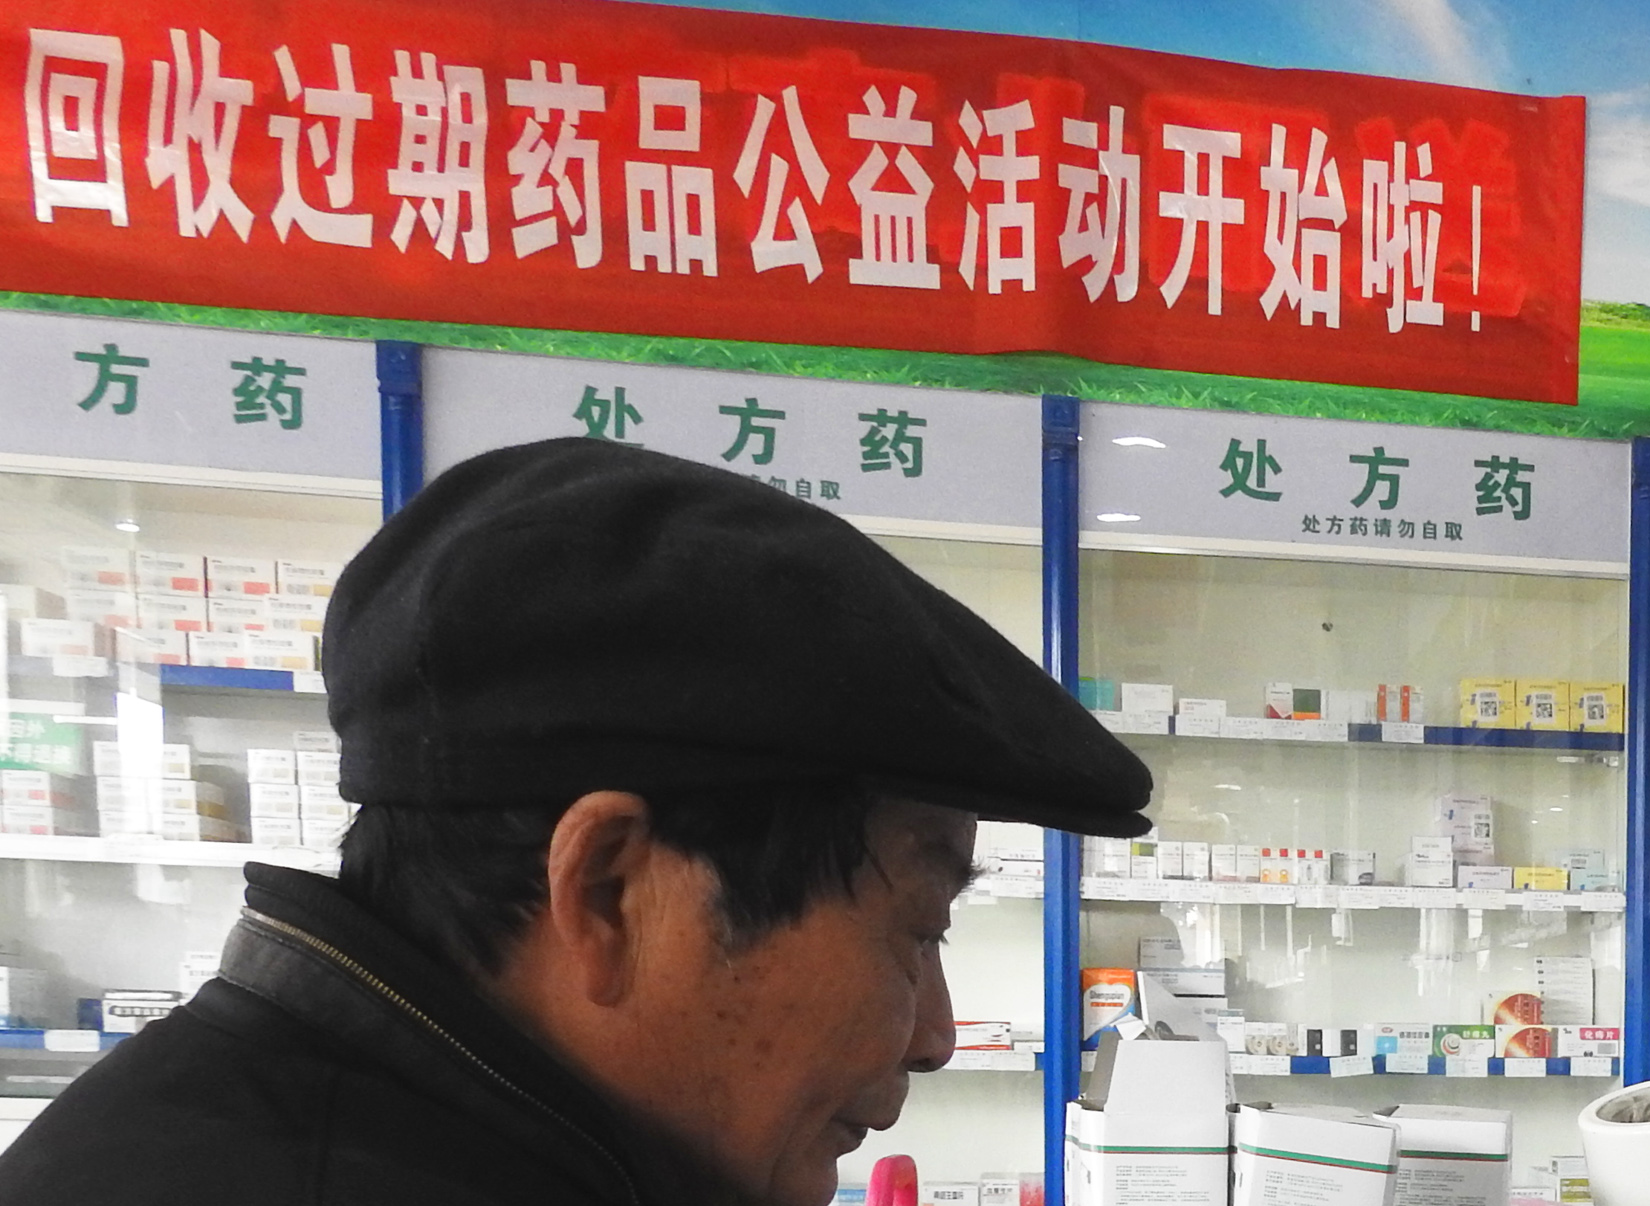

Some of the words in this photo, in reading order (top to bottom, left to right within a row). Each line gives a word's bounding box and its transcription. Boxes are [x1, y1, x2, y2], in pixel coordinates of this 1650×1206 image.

[74, 342, 307, 431] 方药
[572, 384, 927, 478] 处方药
[1219, 437, 1535, 521] 处方药
[1301, 514, 1463, 541] 处方药请勿自取
